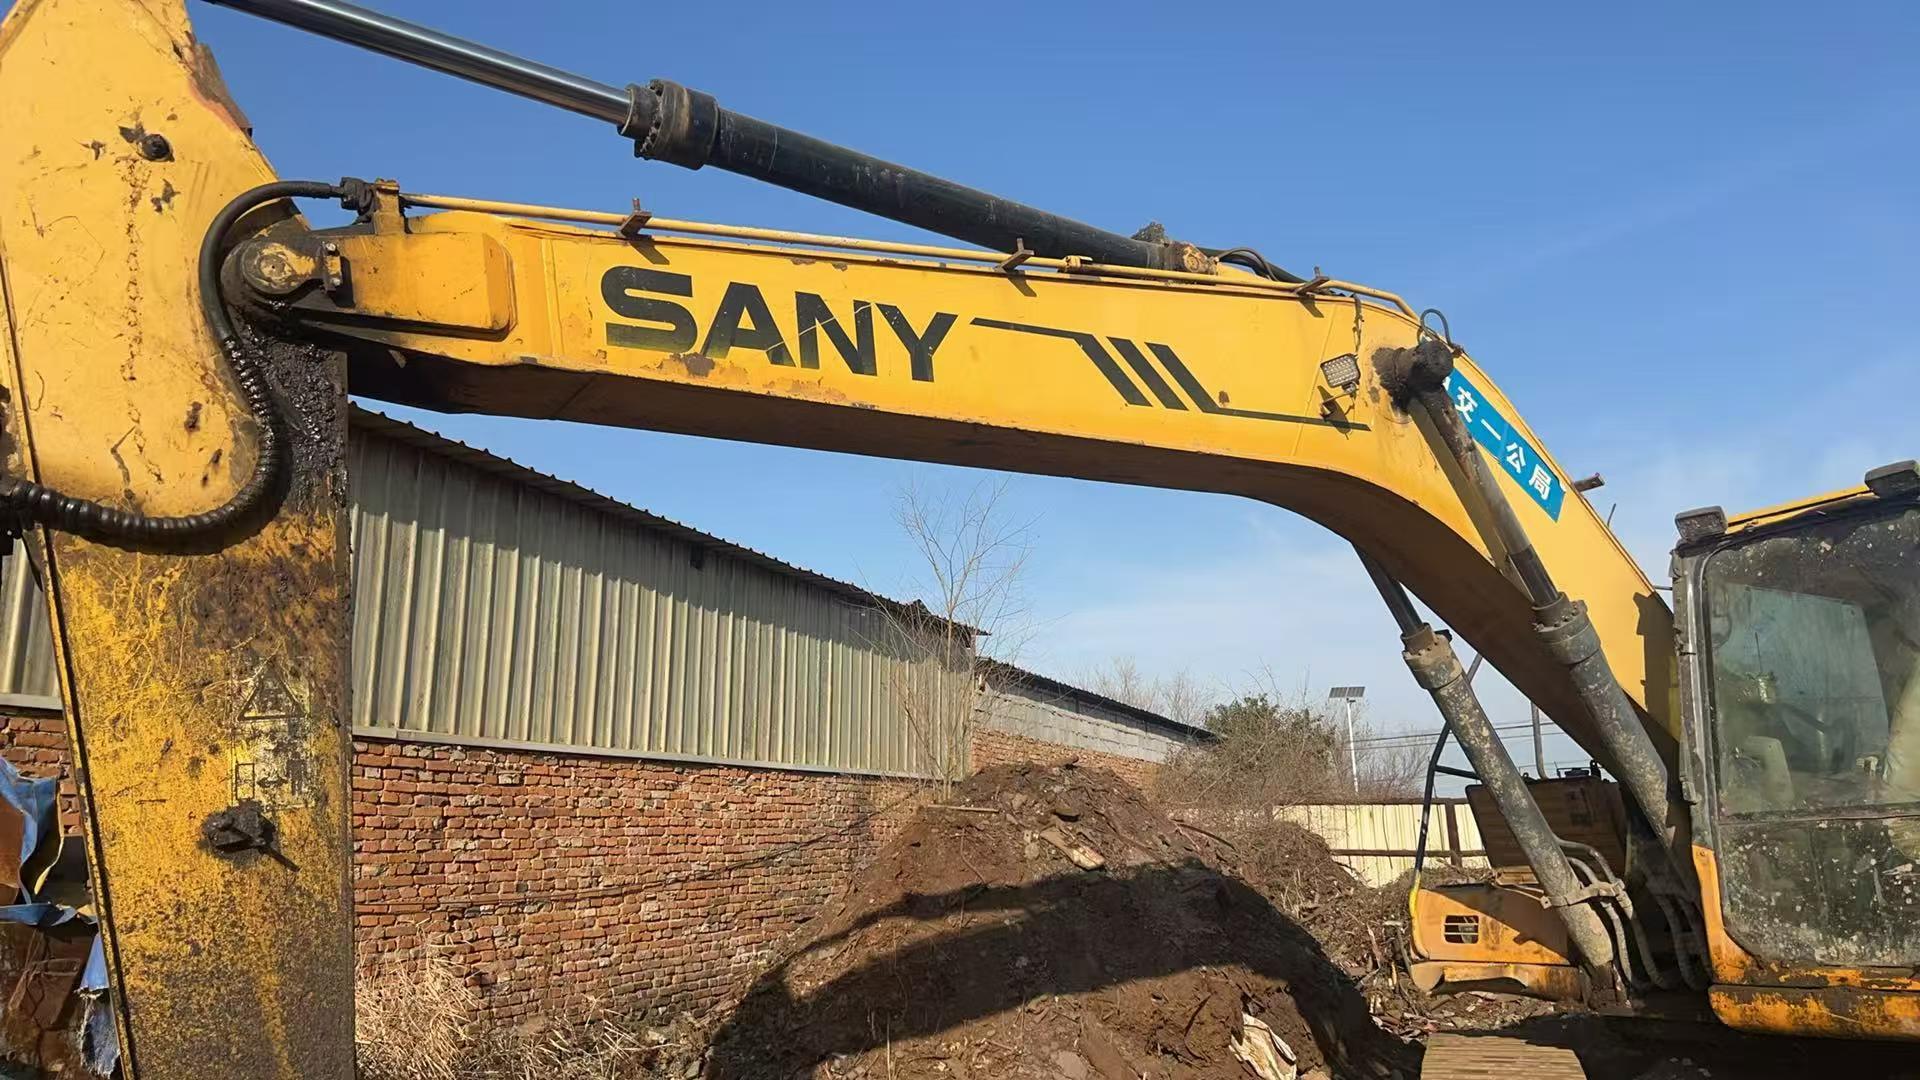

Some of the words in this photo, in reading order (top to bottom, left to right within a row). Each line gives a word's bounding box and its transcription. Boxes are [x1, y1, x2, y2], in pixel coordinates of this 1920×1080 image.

[600, 265, 959, 383] SANY
[1442, 376, 1552, 500] 交一公局
